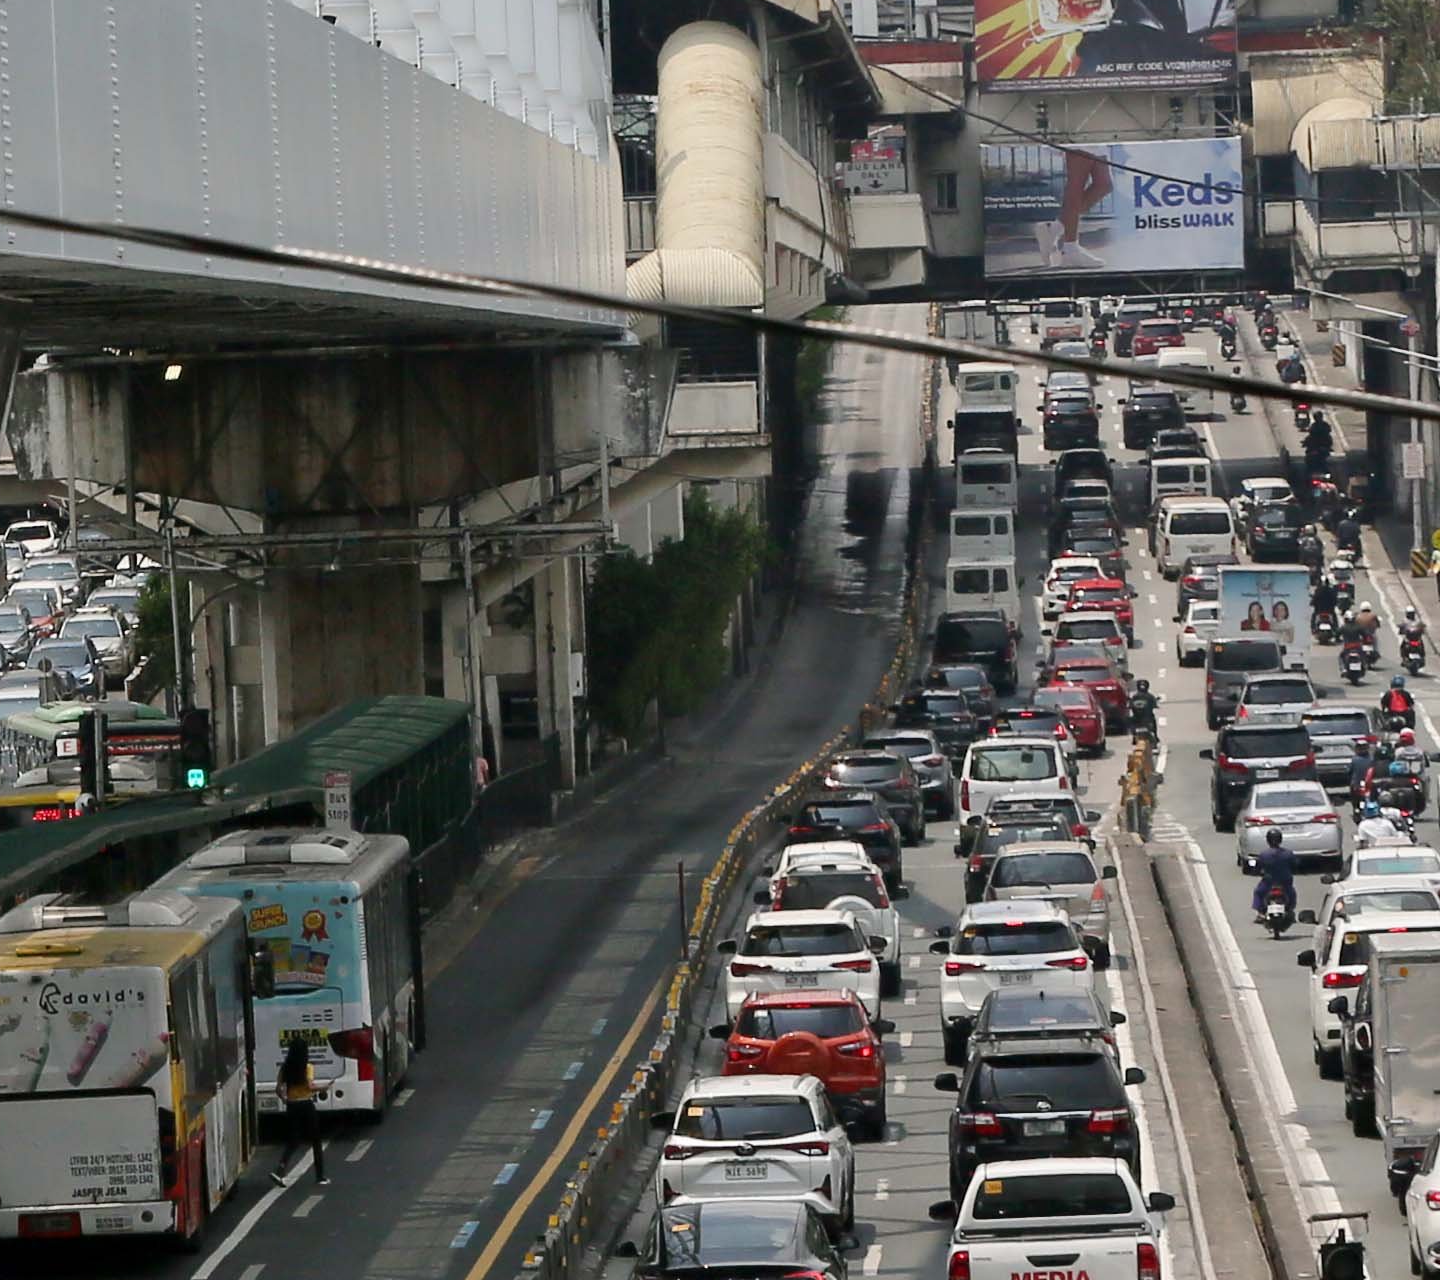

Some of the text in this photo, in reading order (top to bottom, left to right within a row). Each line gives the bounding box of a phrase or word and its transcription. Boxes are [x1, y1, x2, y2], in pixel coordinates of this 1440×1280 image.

[1133, 173, 1235, 208] Keds
[62, 989, 145, 1005] david's
[105, 1186, 128, 1197] JEAN
